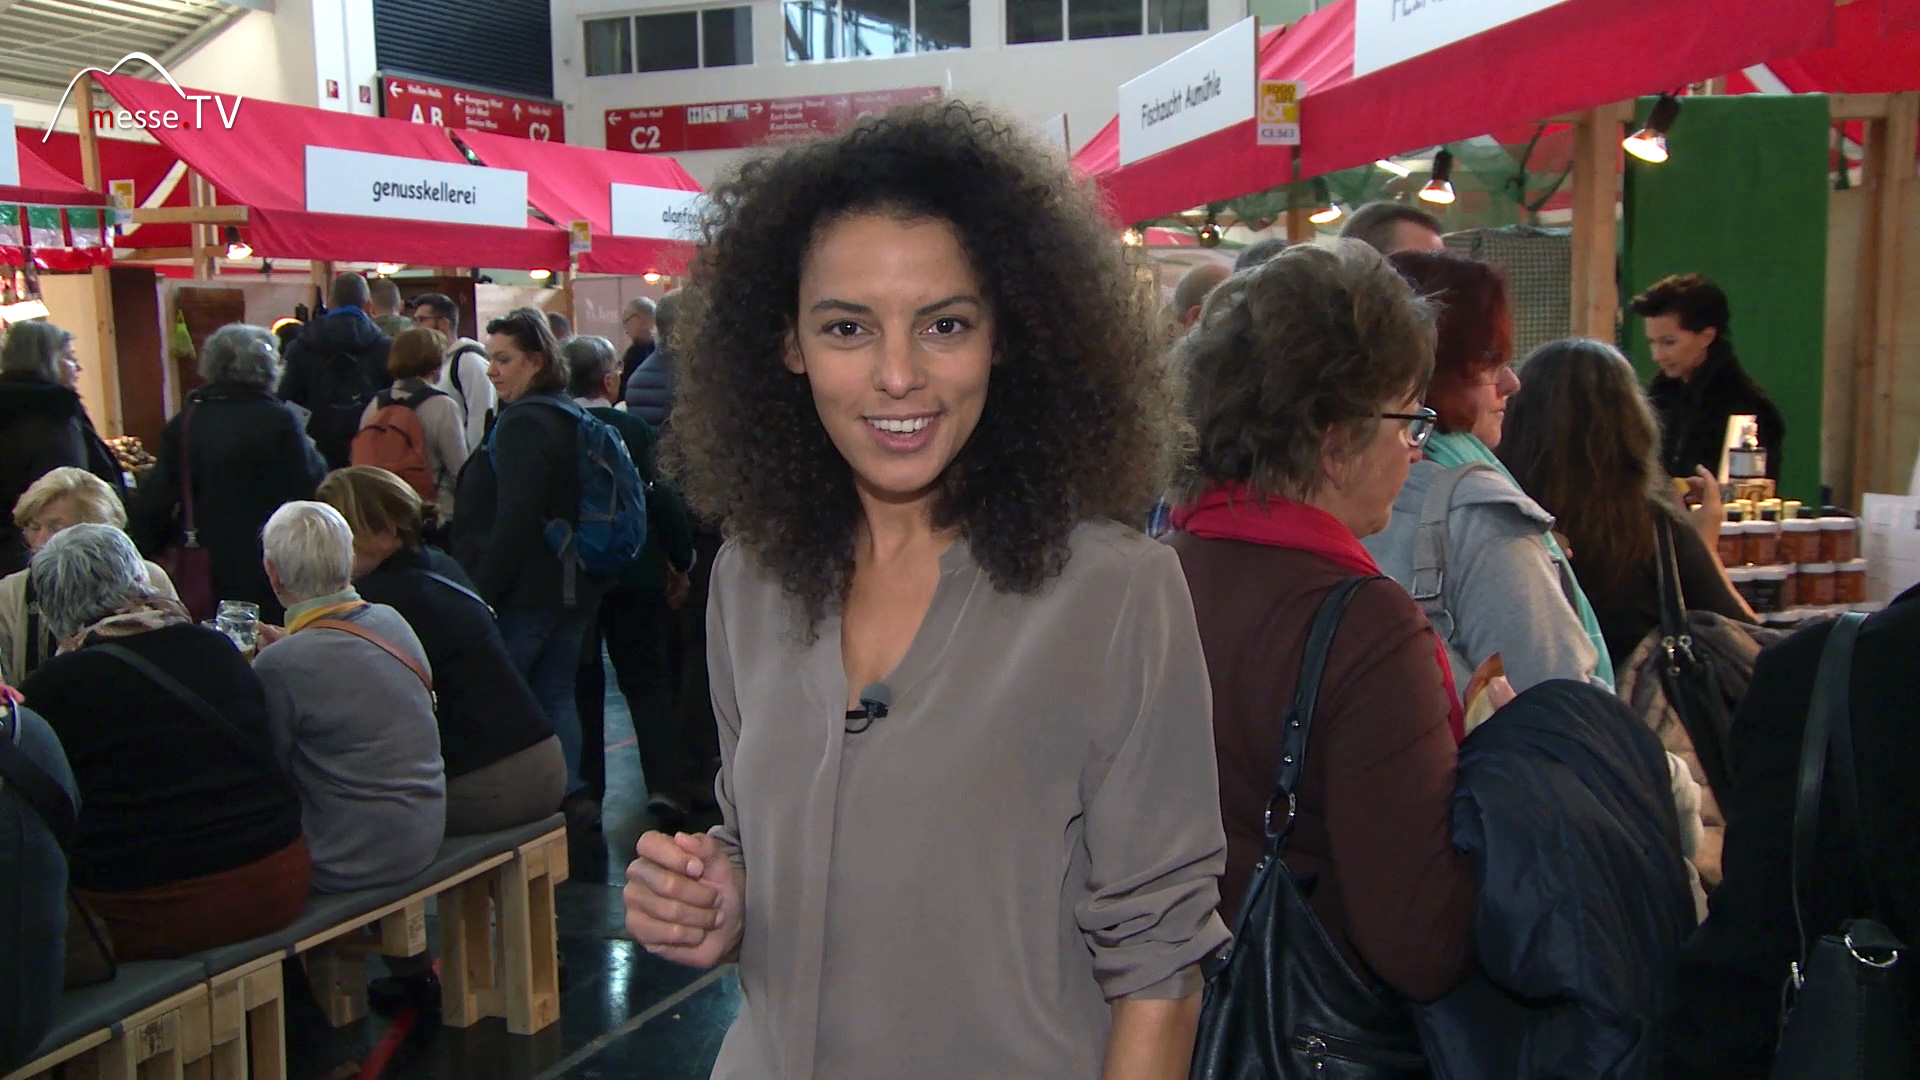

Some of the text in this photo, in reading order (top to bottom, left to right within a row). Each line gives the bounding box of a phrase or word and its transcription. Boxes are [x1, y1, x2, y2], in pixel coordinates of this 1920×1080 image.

[1142, 70, 1221, 129] Fischzucht Aumühle
[630, 125, 661, 150] C2
[372, 179, 476, 205] genusskellerei
